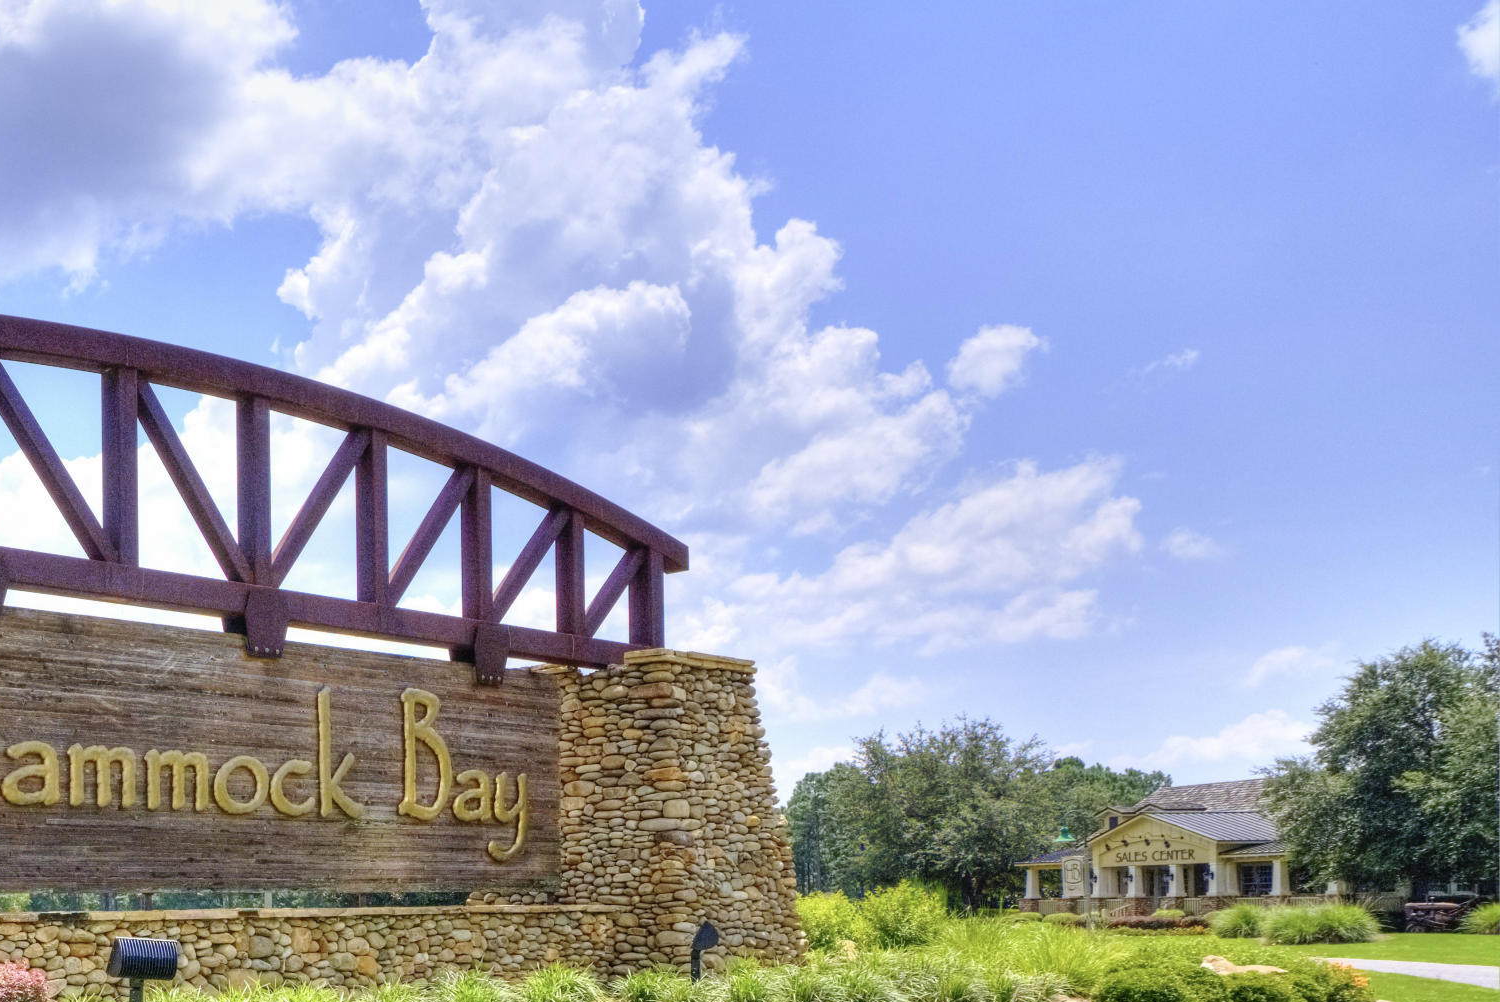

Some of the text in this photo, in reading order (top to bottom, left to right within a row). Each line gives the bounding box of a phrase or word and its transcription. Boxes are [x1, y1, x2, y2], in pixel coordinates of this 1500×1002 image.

[398, 687, 528, 862] Bay
[1116, 849, 1195, 862] SALES CENTER
